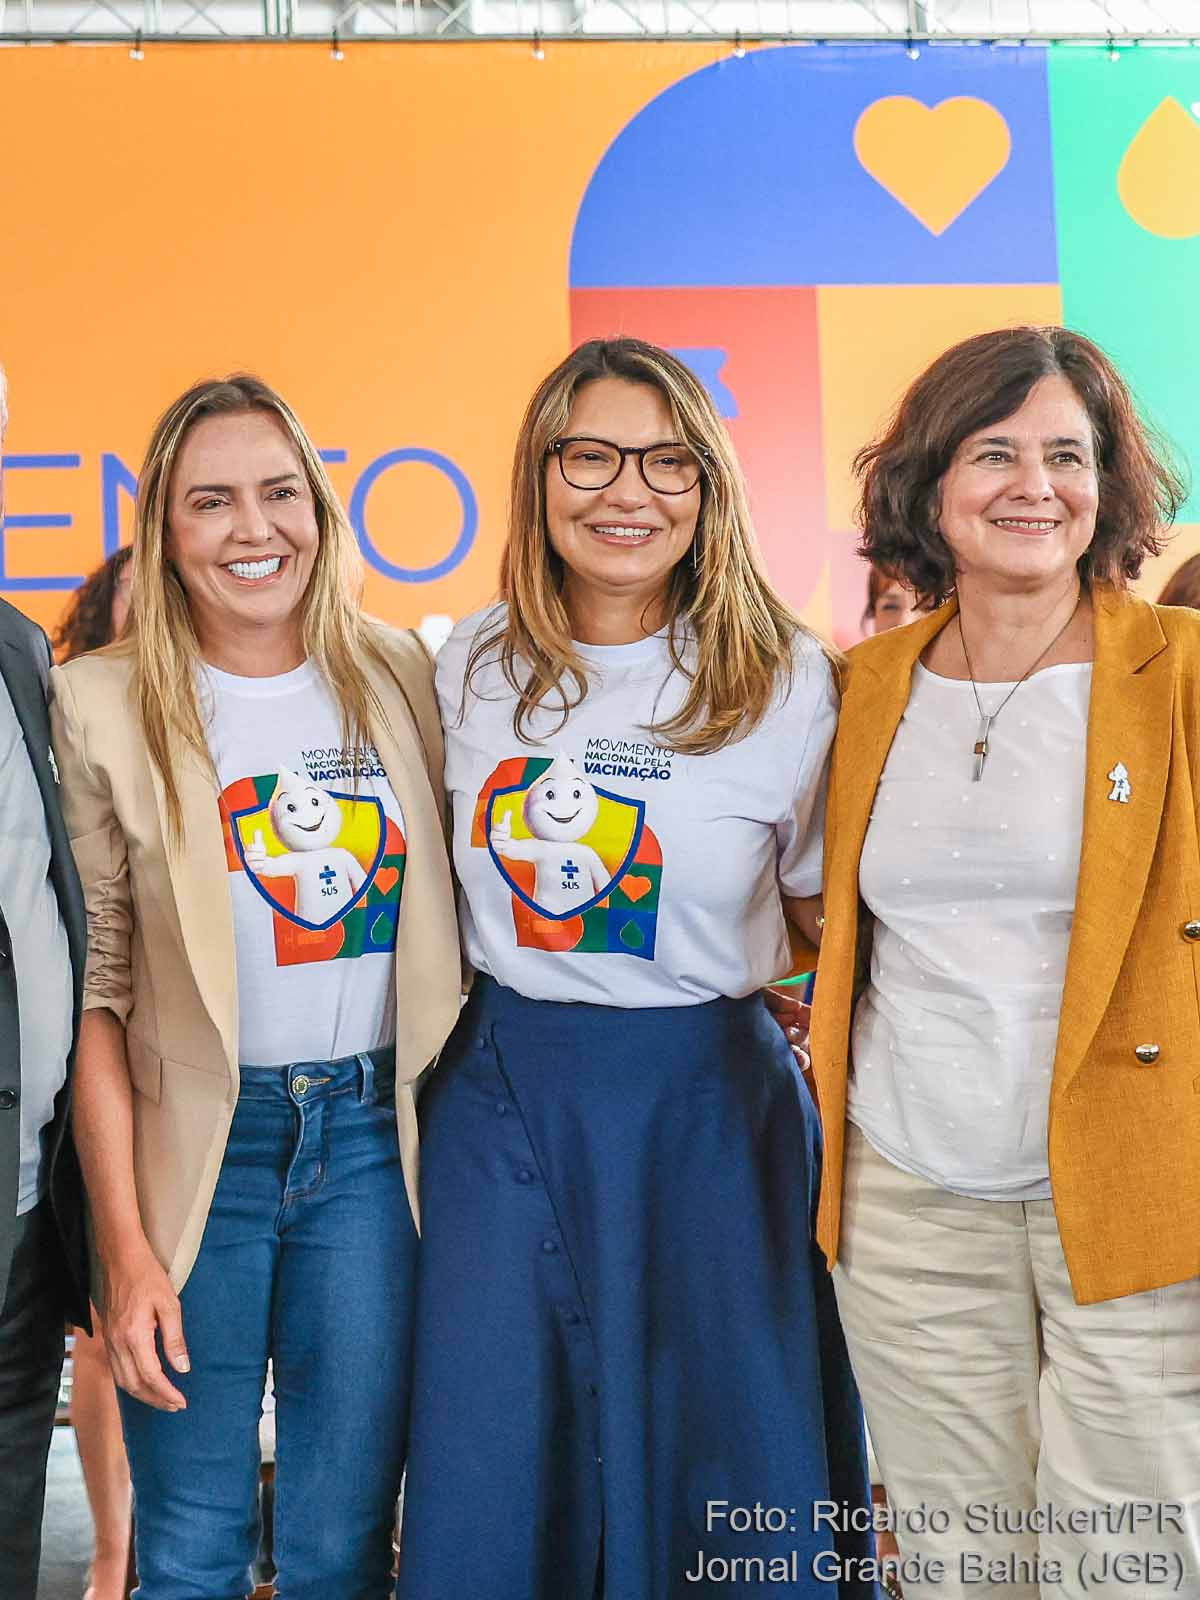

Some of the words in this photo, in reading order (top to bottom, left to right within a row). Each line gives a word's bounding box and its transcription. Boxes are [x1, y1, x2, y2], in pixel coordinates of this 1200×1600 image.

[586, 738, 675, 758] MOVIMENTO
[585, 752, 641, 765] NACIONAL
[643, 758, 672, 768] PELA
[583, 762, 672, 781] VACINAÇÃO
[321, 886, 338, 896] SUS
[561, 881, 580, 890] SUS
